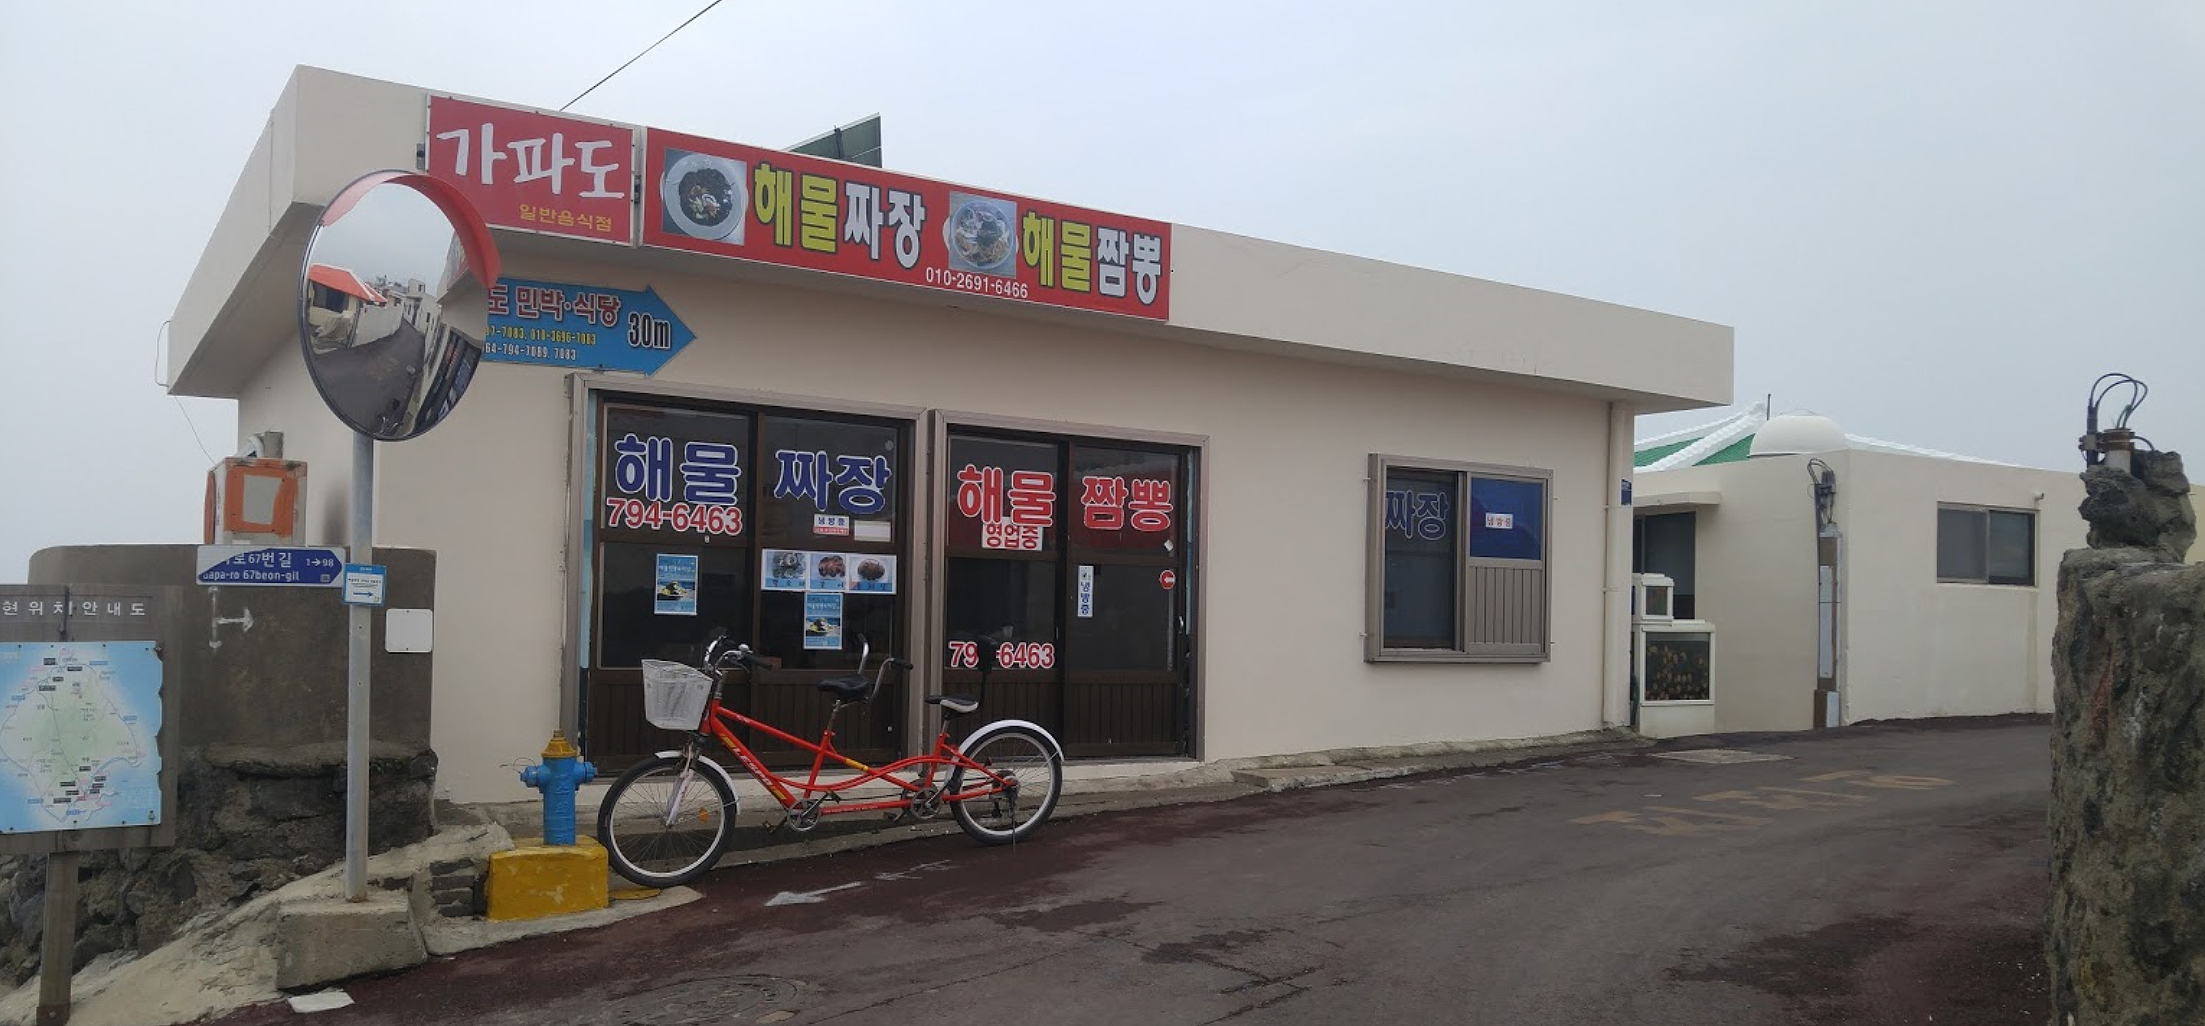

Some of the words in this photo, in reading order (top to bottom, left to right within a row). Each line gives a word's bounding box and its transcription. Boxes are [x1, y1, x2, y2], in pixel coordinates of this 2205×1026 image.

[436, 122, 625, 199] 가파도
[519, 203, 613, 233] 일반음식점
[753, 162, 927, 270] 해물짜장
[1021, 211, 1164, 305] 해물짬뽕
[926, 266, 1029, 299] 010-2691-6466
[516, 285, 622, 328] 민박·식당
[628, 311, 672, 350] 30m
[614, 433, 742, 506] 해물
[773, 449, 892, 514] 짜장
[606, 497, 743, 536] 794-6463
[957, 464, 1056, 528] 해물
[1081, 476, 1174, 532] 짬뽕
[1384, 489, 1451, 541] 짜장
[986, 522, 1039, 549] 영업중
[243, 569, 300, 582] 67beon-gil
[1080, 581, 1091, 615] 냉방중
[949, 641, 1055, 669] 79-6463
